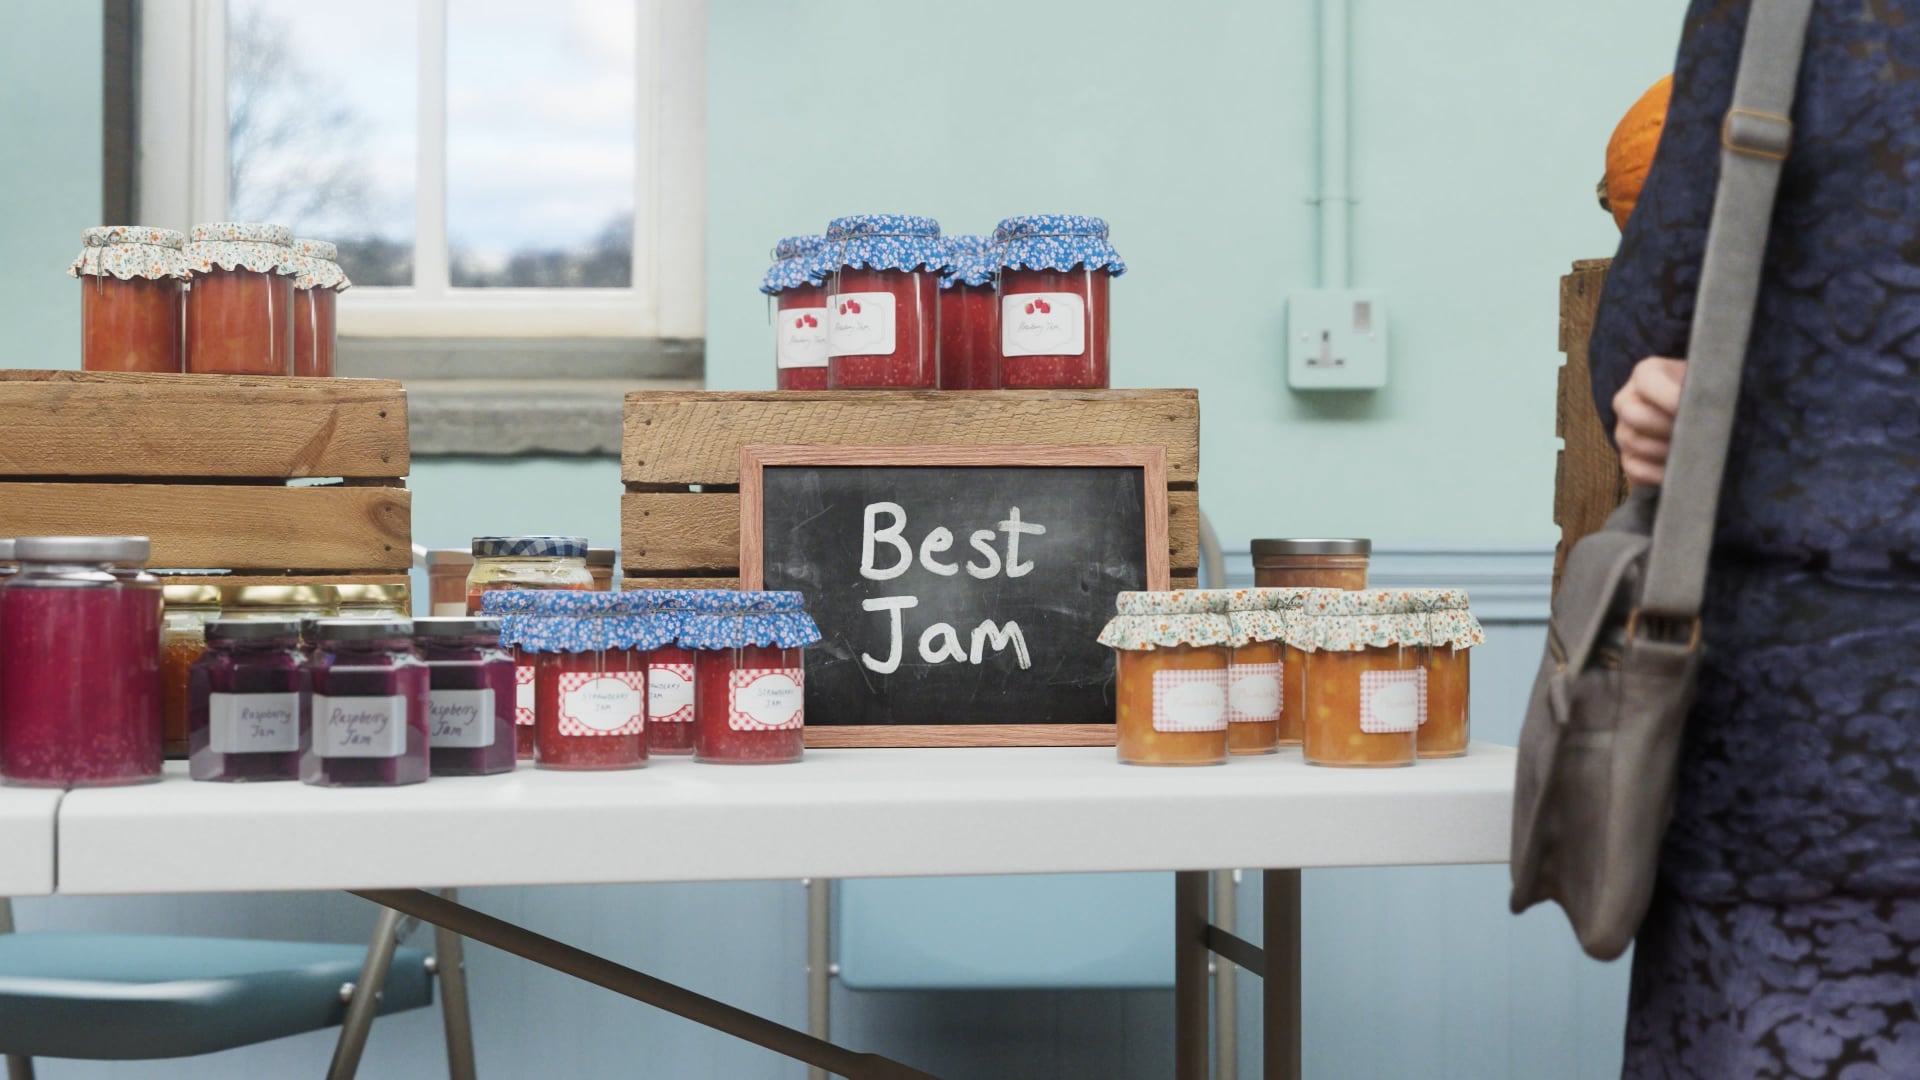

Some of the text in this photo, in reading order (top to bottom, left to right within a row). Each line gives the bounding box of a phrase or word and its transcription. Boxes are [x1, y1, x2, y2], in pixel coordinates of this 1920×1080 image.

[860, 501, 1046, 580] Best
[861, 595, 1031, 674] Jam
[250, 724, 276, 738] Jam
[338, 728, 372, 746] Jam
[431, 720, 463, 737] Jam
